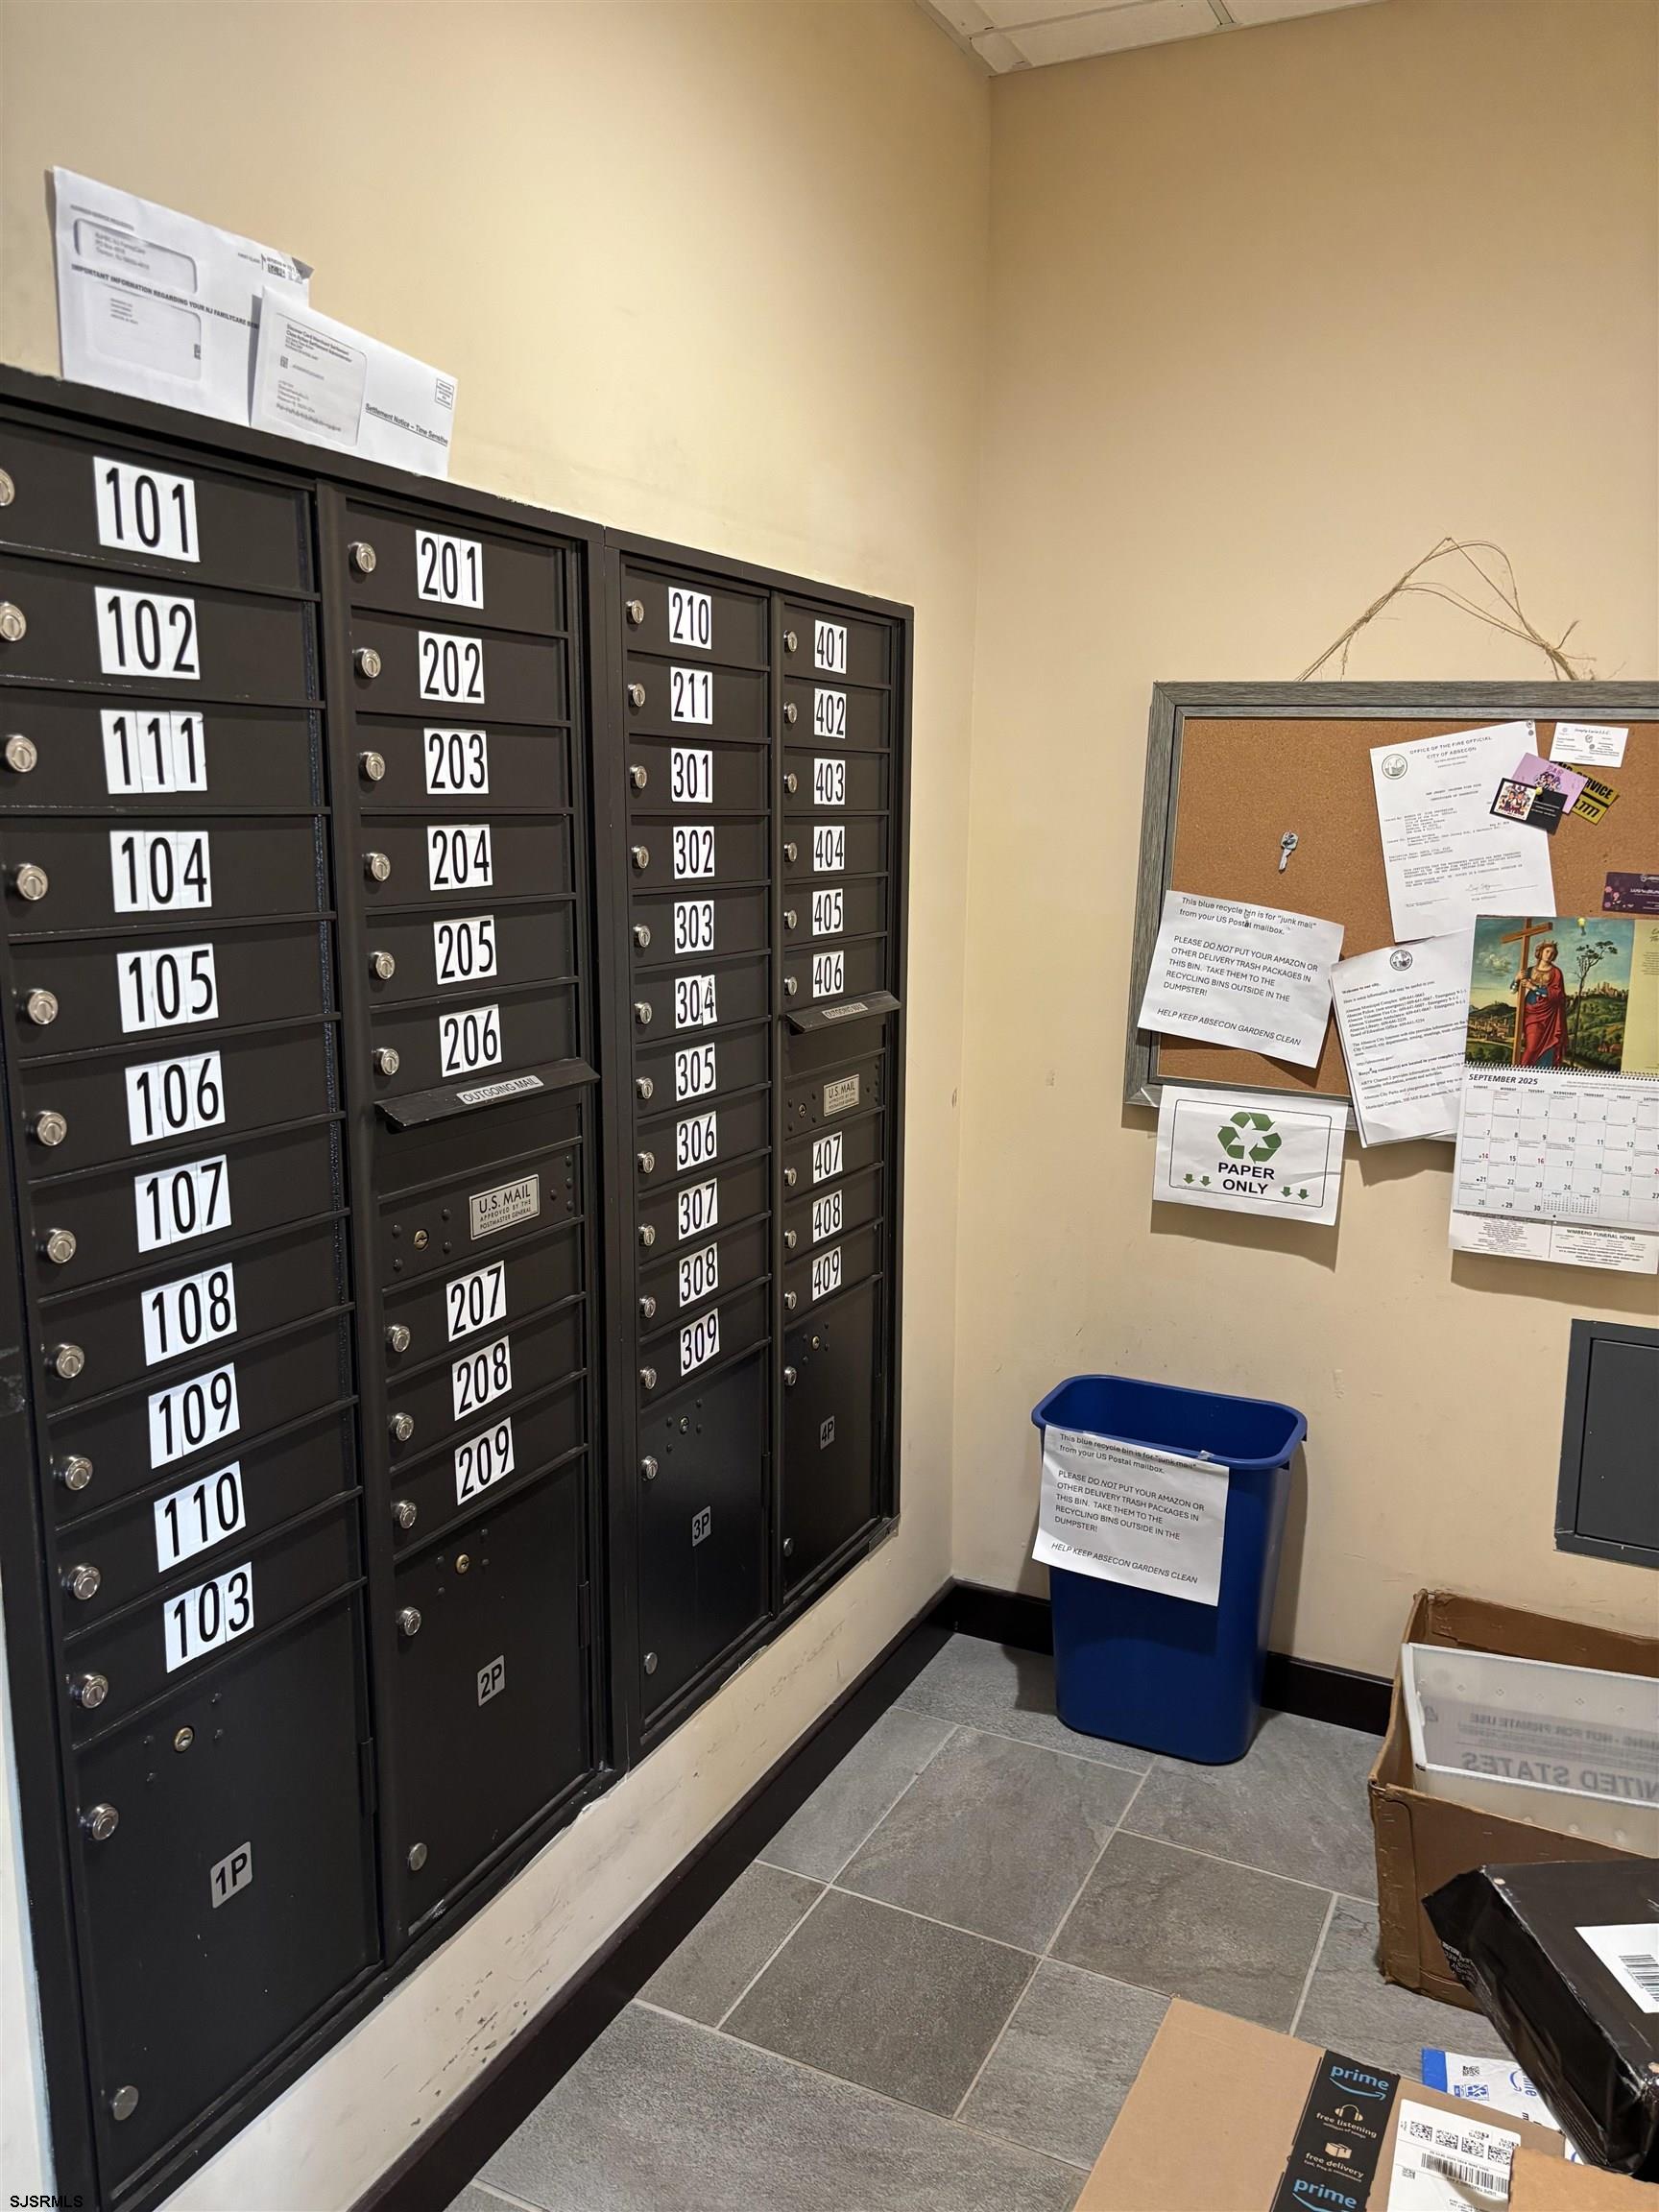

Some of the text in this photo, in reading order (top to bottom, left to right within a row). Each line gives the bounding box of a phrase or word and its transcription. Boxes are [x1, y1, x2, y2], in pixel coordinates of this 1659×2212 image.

[106, 467, 189, 553] 101
[421, 537, 477, 602] 201
[108, 595, 195, 673] 102
[672, 591, 709, 645] 210
[423, 637, 481, 698] 202
[816, 626, 844, 669] 401
[673, 671, 709, 719] 211
[815, 693, 845, 736] 402
[112, 716, 197, 785] 111
[428, 733, 486, 789] 203
[673, 752, 709, 799] 301
[815, 762, 844, 803] 403
[121, 836, 207, 904] 104
[432, 830, 490, 885] 204
[675, 830, 713, 876] 302
[815, 829, 843, 868] 404
[676, 903, 712, 950] 303
[814, 892, 842, 932] 405
[1179, 908, 1197, 918] from
[1215, 915, 1227, 924] US
[1253, 924, 1285, 935] mailbox.
[1182, 897, 1197, 905] This
[1198, 900, 1214, 909] blue
[1215, 904, 1243, 914] recycle
[1265, 912, 1276, 921] for
[438, 920, 493, 979] 205
[1171, 947, 1311, 983] OTHER DELIVERY TRASH PACKAGES IN
[1174, 935, 1318, 972] PLEASE DO NOT PUT YOUR AMAZON OR
[129, 950, 213, 1022] 105
[814, 954, 842, 994] 406
[1164, 981, 1208, 997] DUMPSTER!
[1166, 970, 1210, 985] RECYCLING
[1211, 978, 1230, 989] BINS
[1231, 983, 1264, 997] OUTSIDE
[1276, 993, 1290, 1002] THE
[1169, 958, 1275, 986] THIS BIN. TAKE THEM TO THE
[677, 979, 715, 1024] 304
[444, 1010, 498, 1071] 206
[1157, 1008, 1301, 1046] HELP KEEP ABSECON GARDENS CLEAN
[463, 1077, 539, 1103] OUTGOING MAIL
[678, 1046, 714, 1096] 305
[1469, 1073, 1517, 1084] SEPTEMBER
[136, 1058, 219, 1136] 106
[678, 1116, 715, 1166] 306
[814, 1134, 841, 1178] 407
[1218, 1162, 1275, 1180] PAPER
[1222, 1179, 1268, 1195] ONLY
[146, 1161, 224, 1240] 107
[479, 1184, 530, 1214] U.S. MAIL
[480, 1207, 509, 1222] APPROVED
[680, 1182, 715, 1235] 307
[814, 1193, 841, 1238] 408
[480, 1214, 511, 1229] POSTMASTER
[681, 1247, 716, 1302] 308
[814, 1250, 840, 1295] 409
[152, 1271, 231, 1354] 108
[450, 1264, 502, 1336] 207
[682, 1313, 717, 1370] 309
[456, 1341, 508, 1414] 208
[158, 1371, 232, 1455] 109
[821, 1420, 833, 1442] 4P
[458, 1425, 510, 1500] 209
[1056, 1493, 1163, 1524] THIS BIN. TAKE THEM TO THE
[1057, 1482, 1084, 1493] OTHER
[1085, 1487, 1121, 1502] DELIVERY
[1122, 1496, 1146, 1508] TRASH
[1148, 1503, 1190, 1519] PACKAGES
[1058, 1470, 1205, 1511] PLEASE DO NOT PUT YOUR AMAZON OR
[164, 1472, 239, 1558] 110
[693, 1512, 709, 1540] 3P
[1055, 1504, 1099, 1521] RECYCLING
[1100, 1515, 1118, 1525] BINS
[1119, 1519, 1154, 1534] OUTSIDE
[1165, 1529, 1180, 1540] THE
[1055, 1516, 1097, 1532] DUMPSTER!
[1051, 1543, 1198, 1584] HELP KEEP ABSECON GARDENS CLEAN
[174, 1572, 250, 1659] 103
[480, 1663, 502, 1699] 2P
[215, 1852, 247, 1895] 1P
[1331, 2065, 1389, 2091] prime
[1316, 2112, 1336, 2124] free
[1336, 2118, 1377, 2139] listening
[1305, 2152, 1325, 2164] free
[1326, 2157, 1364, 2178] delivery
[1293, 2179, 1358, 2209] prime
